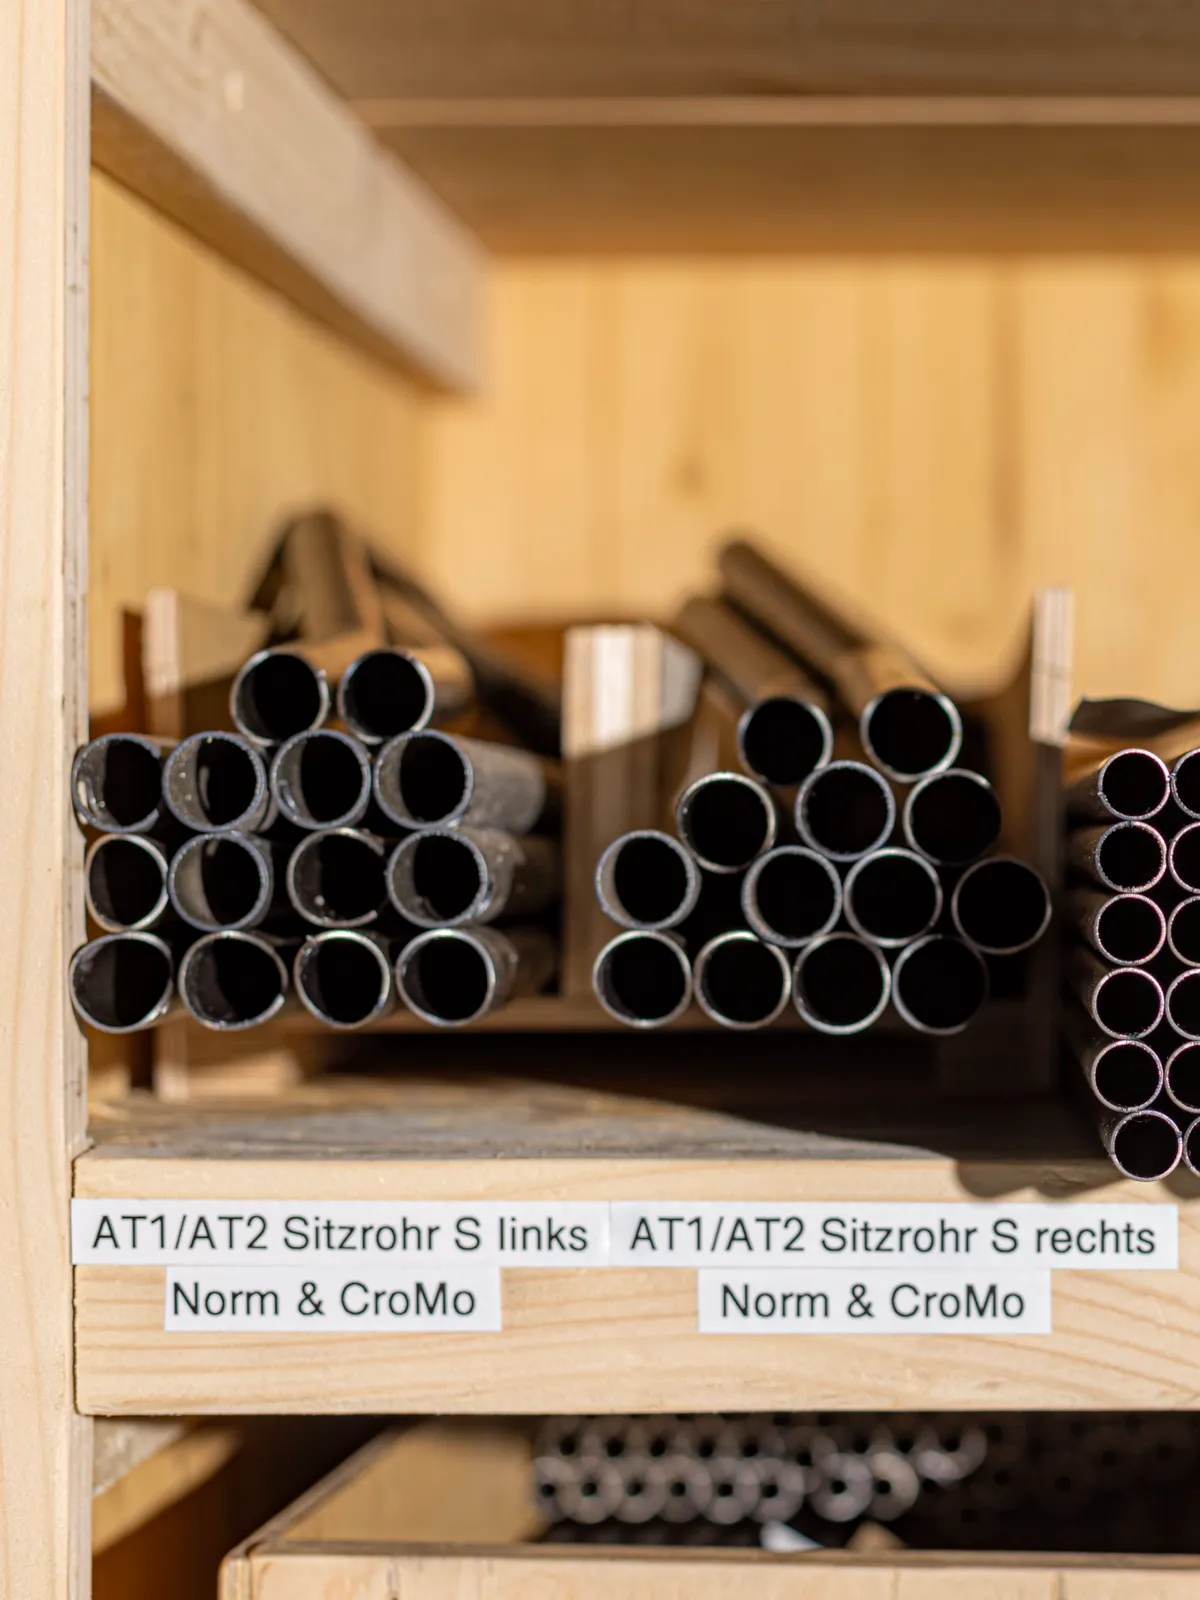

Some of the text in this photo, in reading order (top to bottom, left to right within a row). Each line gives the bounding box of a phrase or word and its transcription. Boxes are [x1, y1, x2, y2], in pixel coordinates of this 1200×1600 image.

[91, 1214, 589, 1253] AT1/AT2 Sitzrohr S links
[629, 1215, 1156, 1255] AT1/AT2 Sitzrohr S rechts
[172, 1280, 476, 1317] Norm & CroMo
[721, 1282, 1026, 1319] Norm & CroMo
